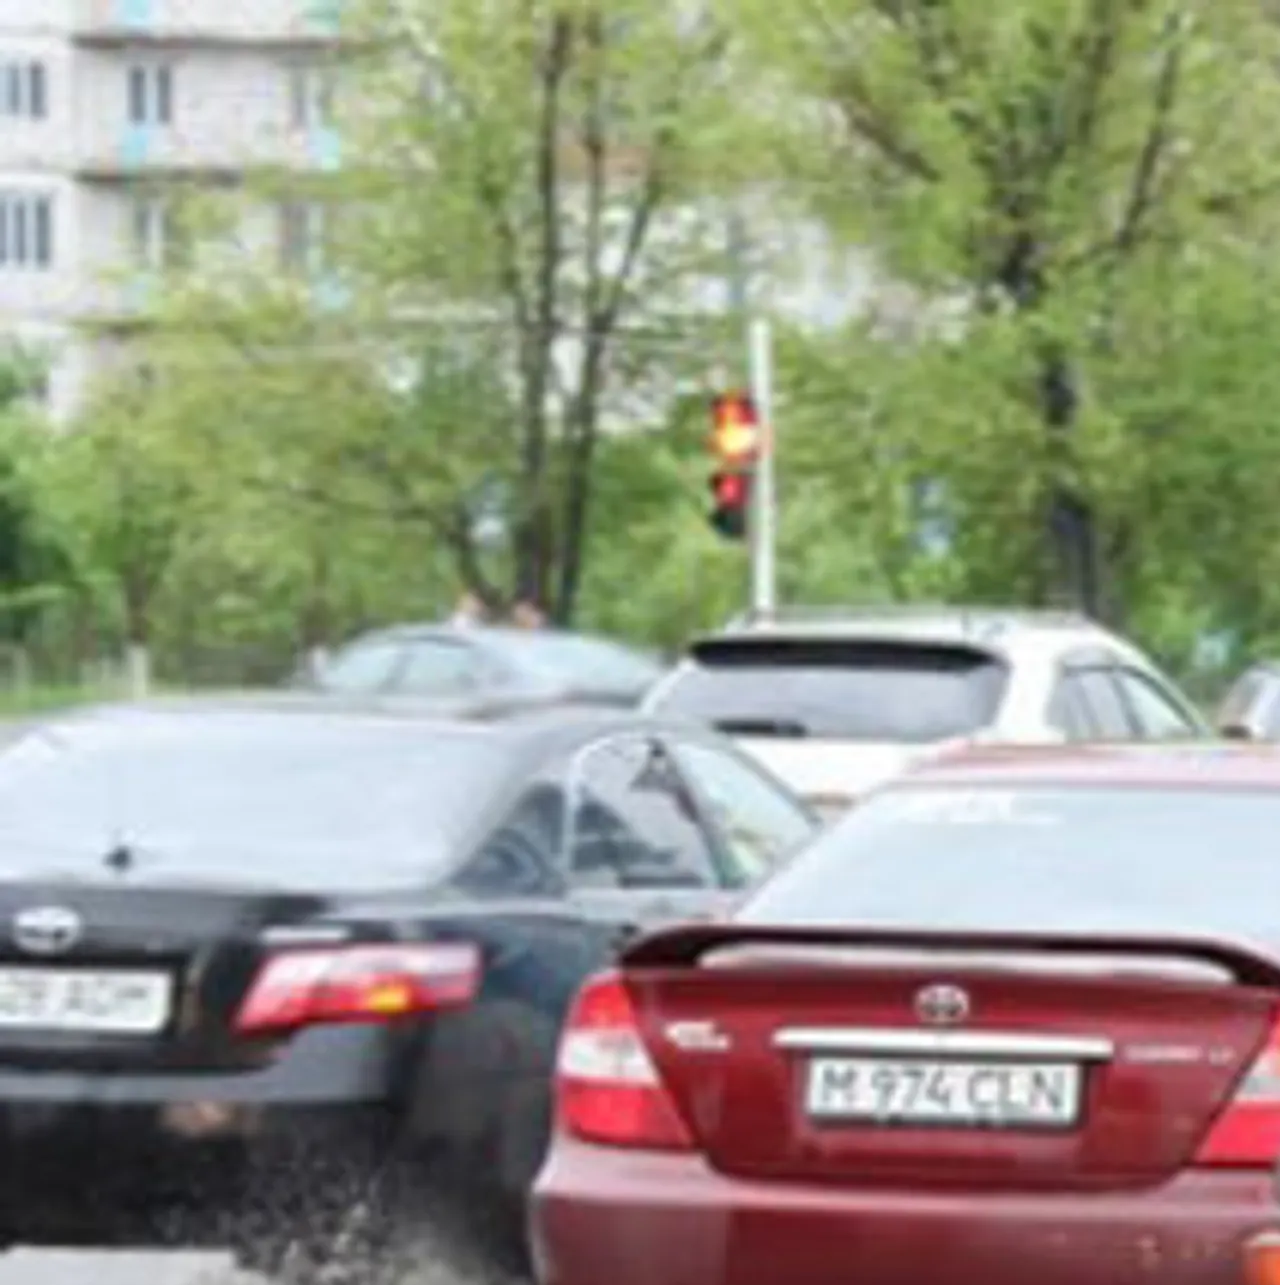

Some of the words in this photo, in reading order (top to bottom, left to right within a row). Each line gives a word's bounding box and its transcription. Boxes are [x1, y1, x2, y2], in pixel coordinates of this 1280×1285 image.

[822, 1064, 857, 1104] M
[870, 1066, 951, 1109] 974
[966, 1069, 1065, 1110] CLN
